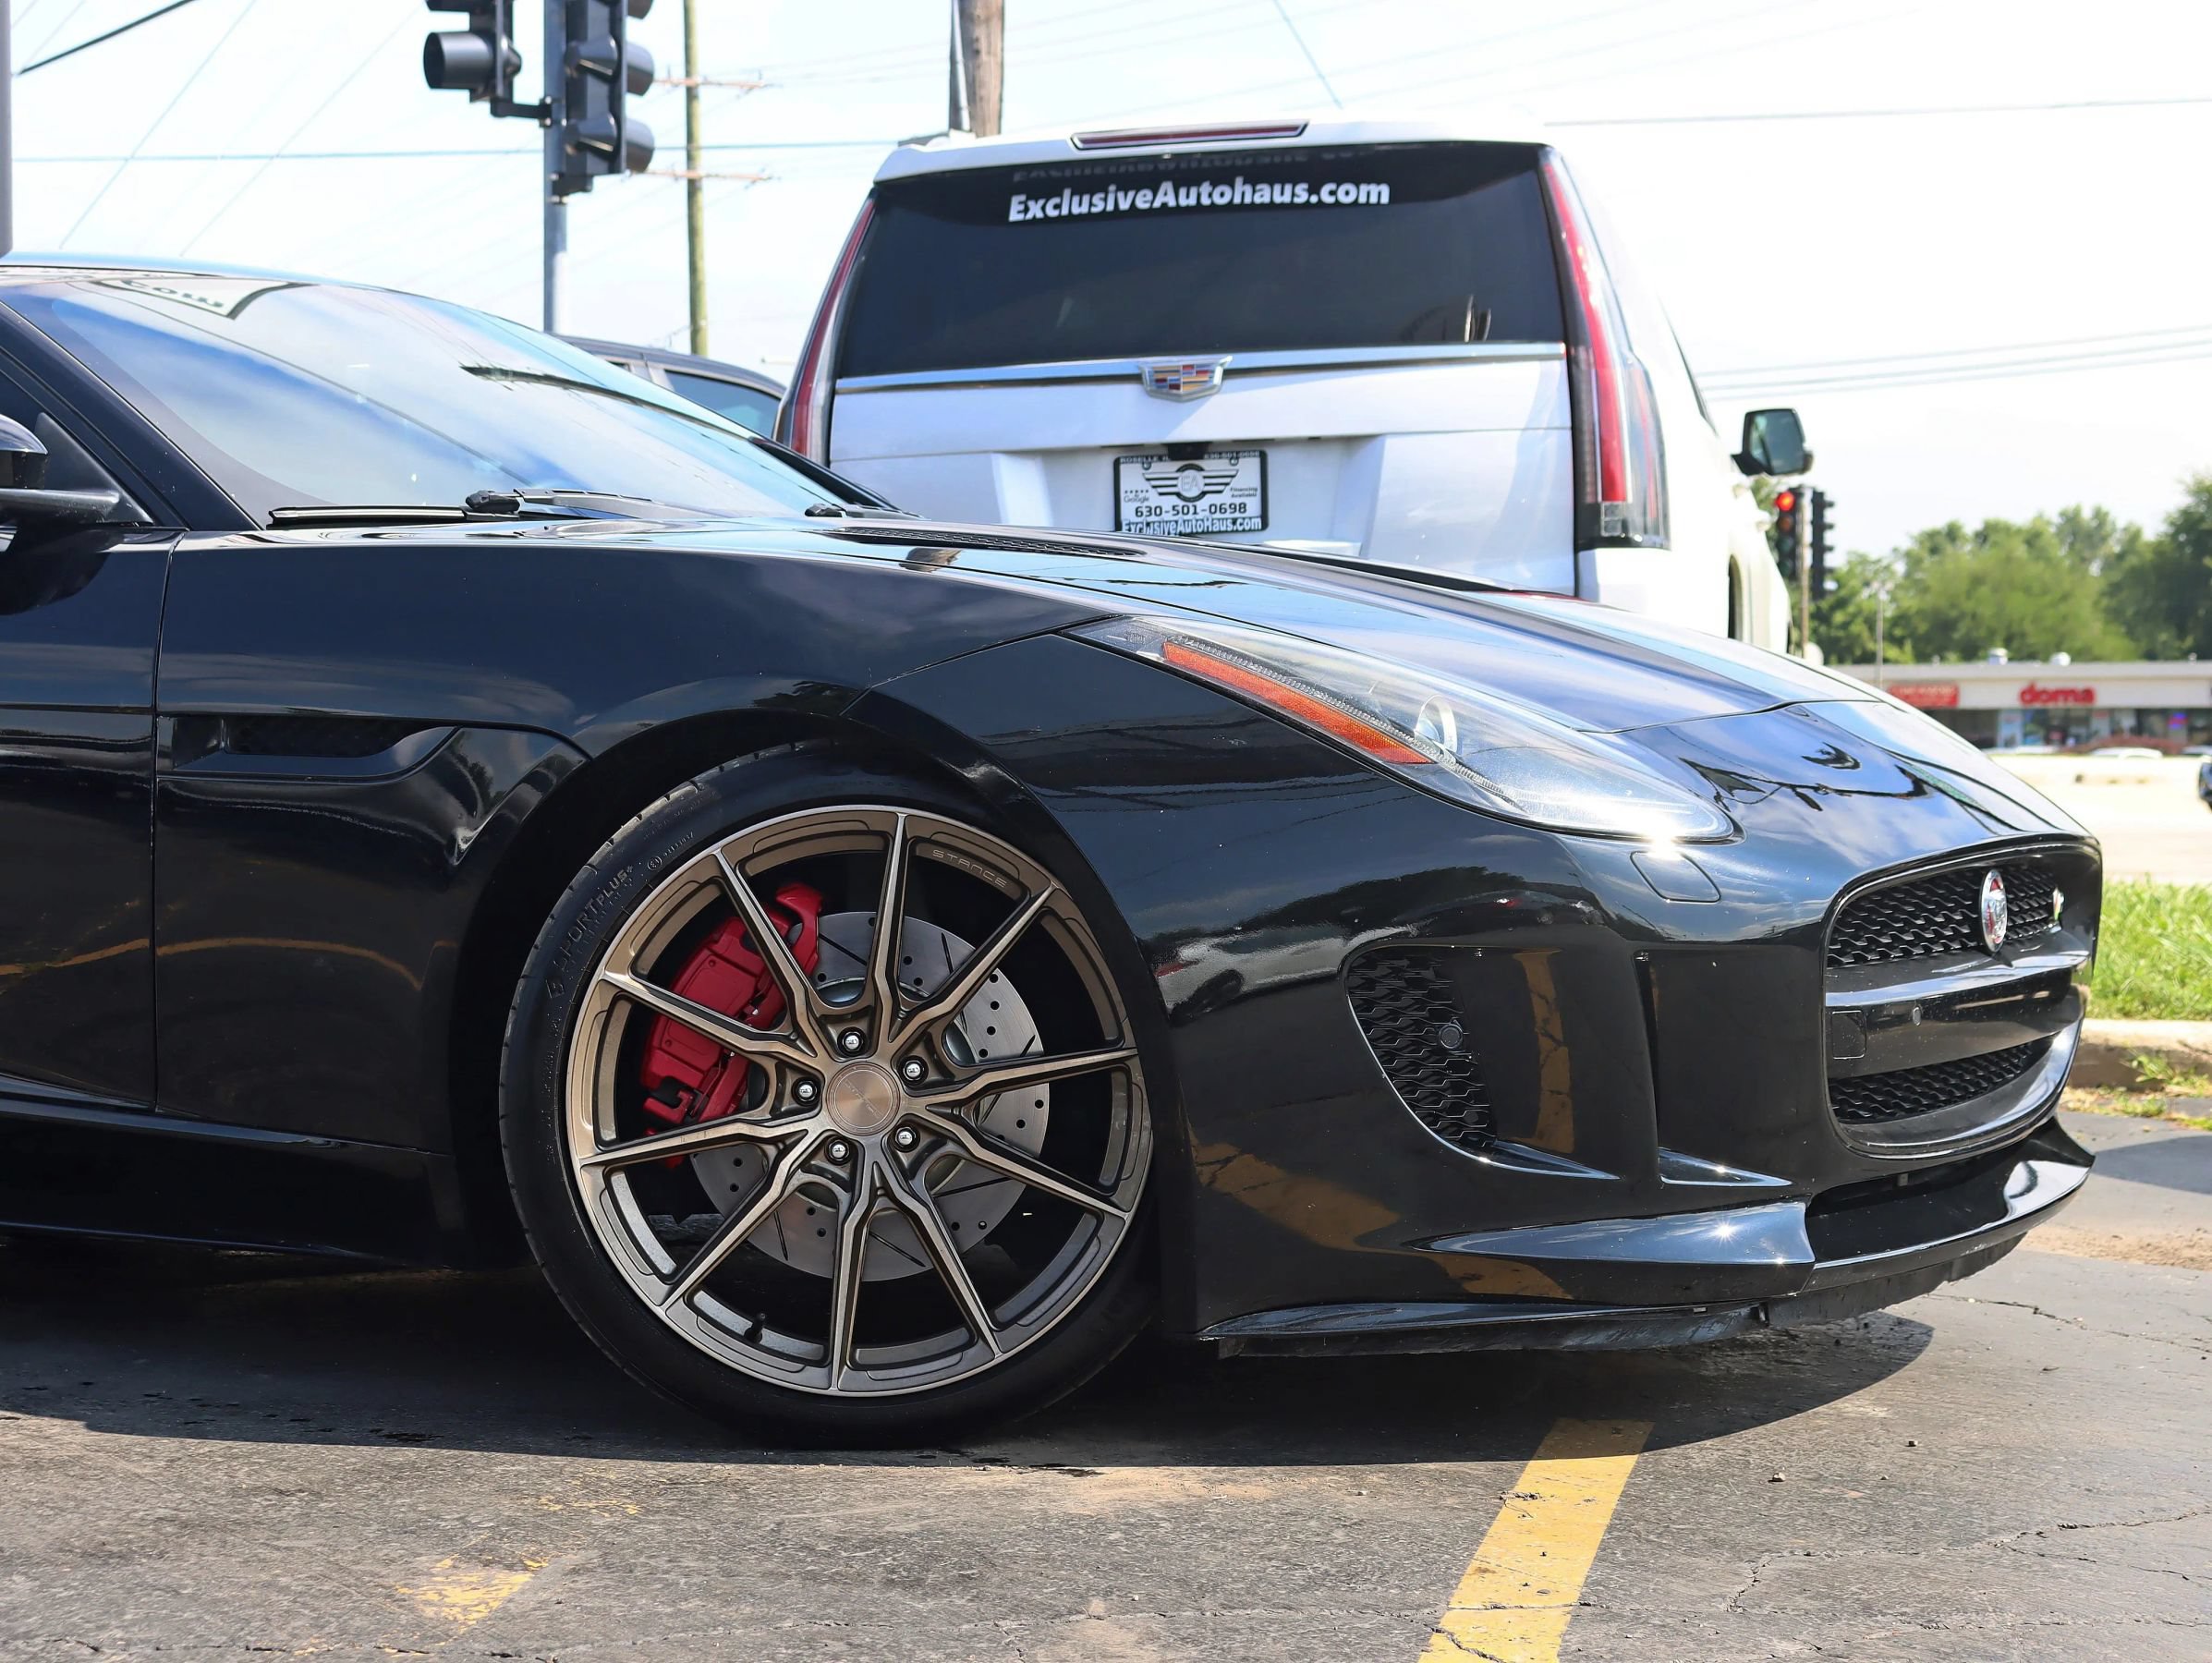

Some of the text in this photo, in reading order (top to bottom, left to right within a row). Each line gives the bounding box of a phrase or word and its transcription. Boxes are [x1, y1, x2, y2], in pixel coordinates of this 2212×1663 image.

[1008, 176, 1391, 222] ExclusiveAutohaus.com
[1124, 495, 1149, 504] Google
[1135, 503, 1247, 517] 630-501-0698
[1122, 517, 1262, 535] ExclusiveAutoHaus.com
[2019, 682, 2095, 706] doma
[932, 849, 1007, 888] STANCE
